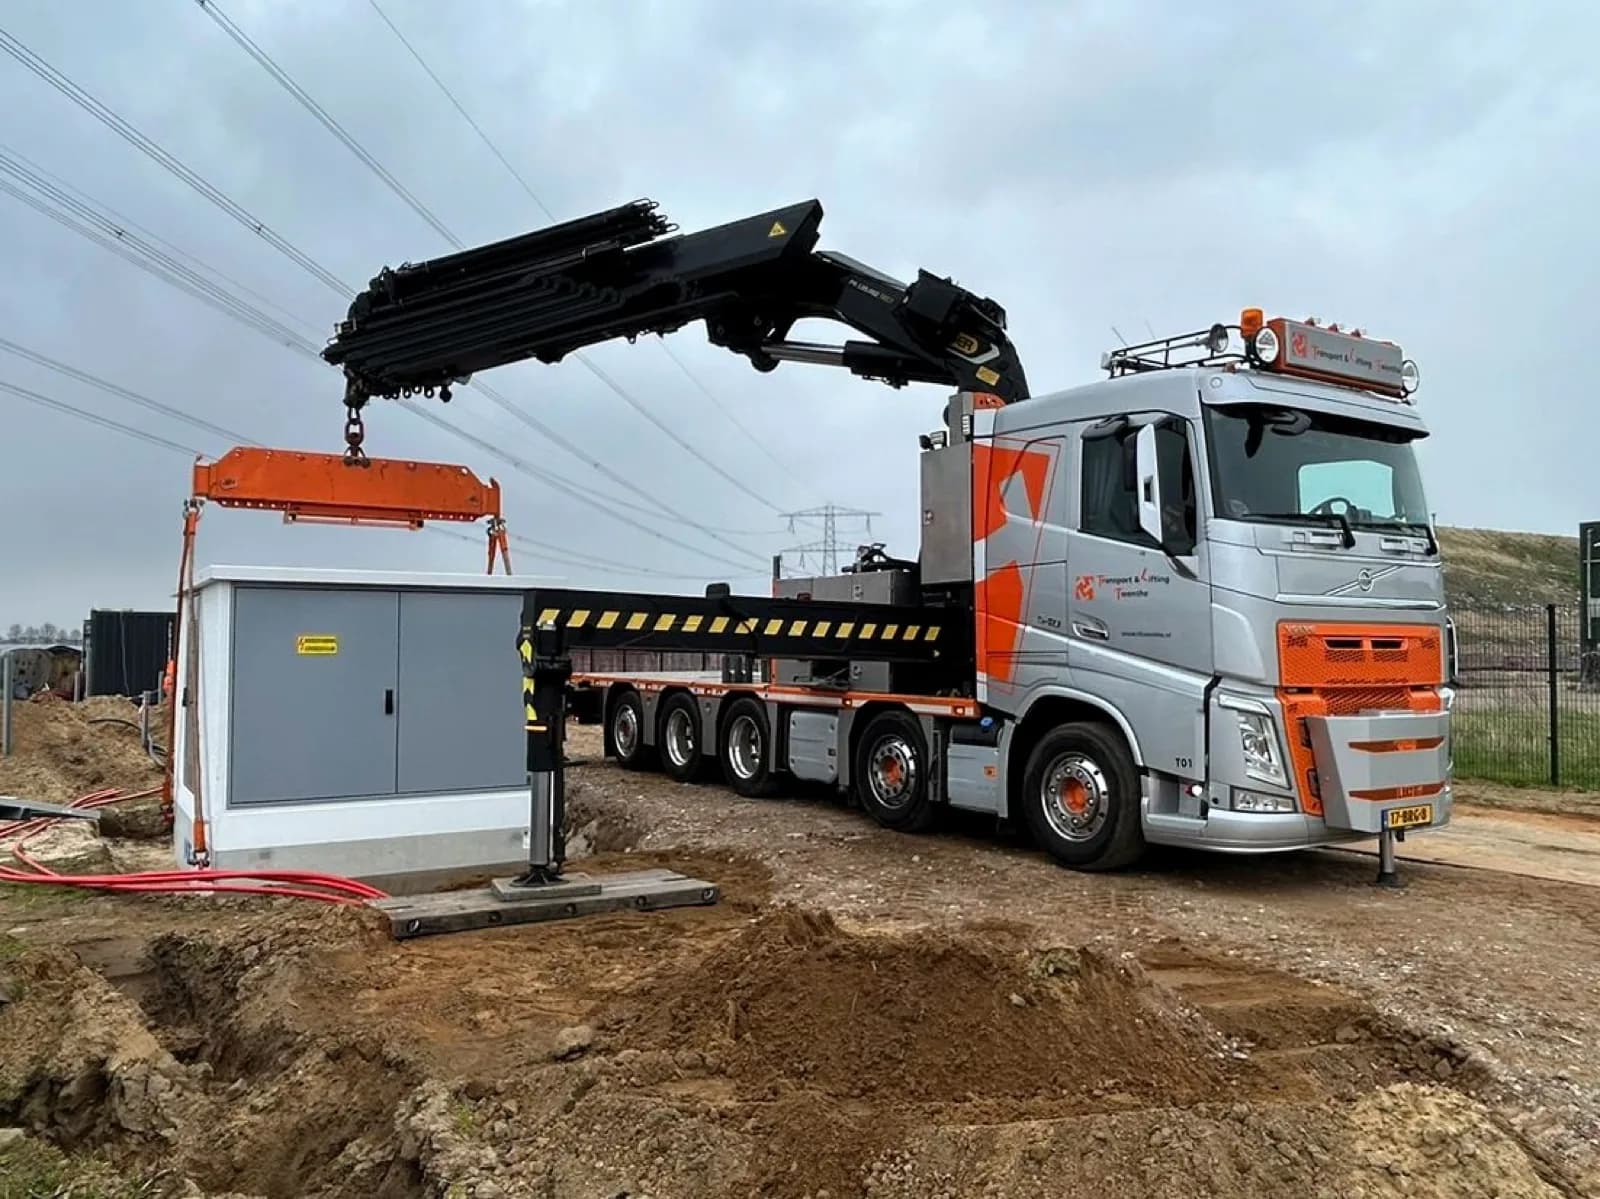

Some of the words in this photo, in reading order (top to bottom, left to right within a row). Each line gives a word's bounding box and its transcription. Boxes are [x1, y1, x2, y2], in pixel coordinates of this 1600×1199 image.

[1096, 574, 1132, 587] Transport
[1140, 568, 1170, 585] Lifting
[1175, 757, 1193, 768] T01
